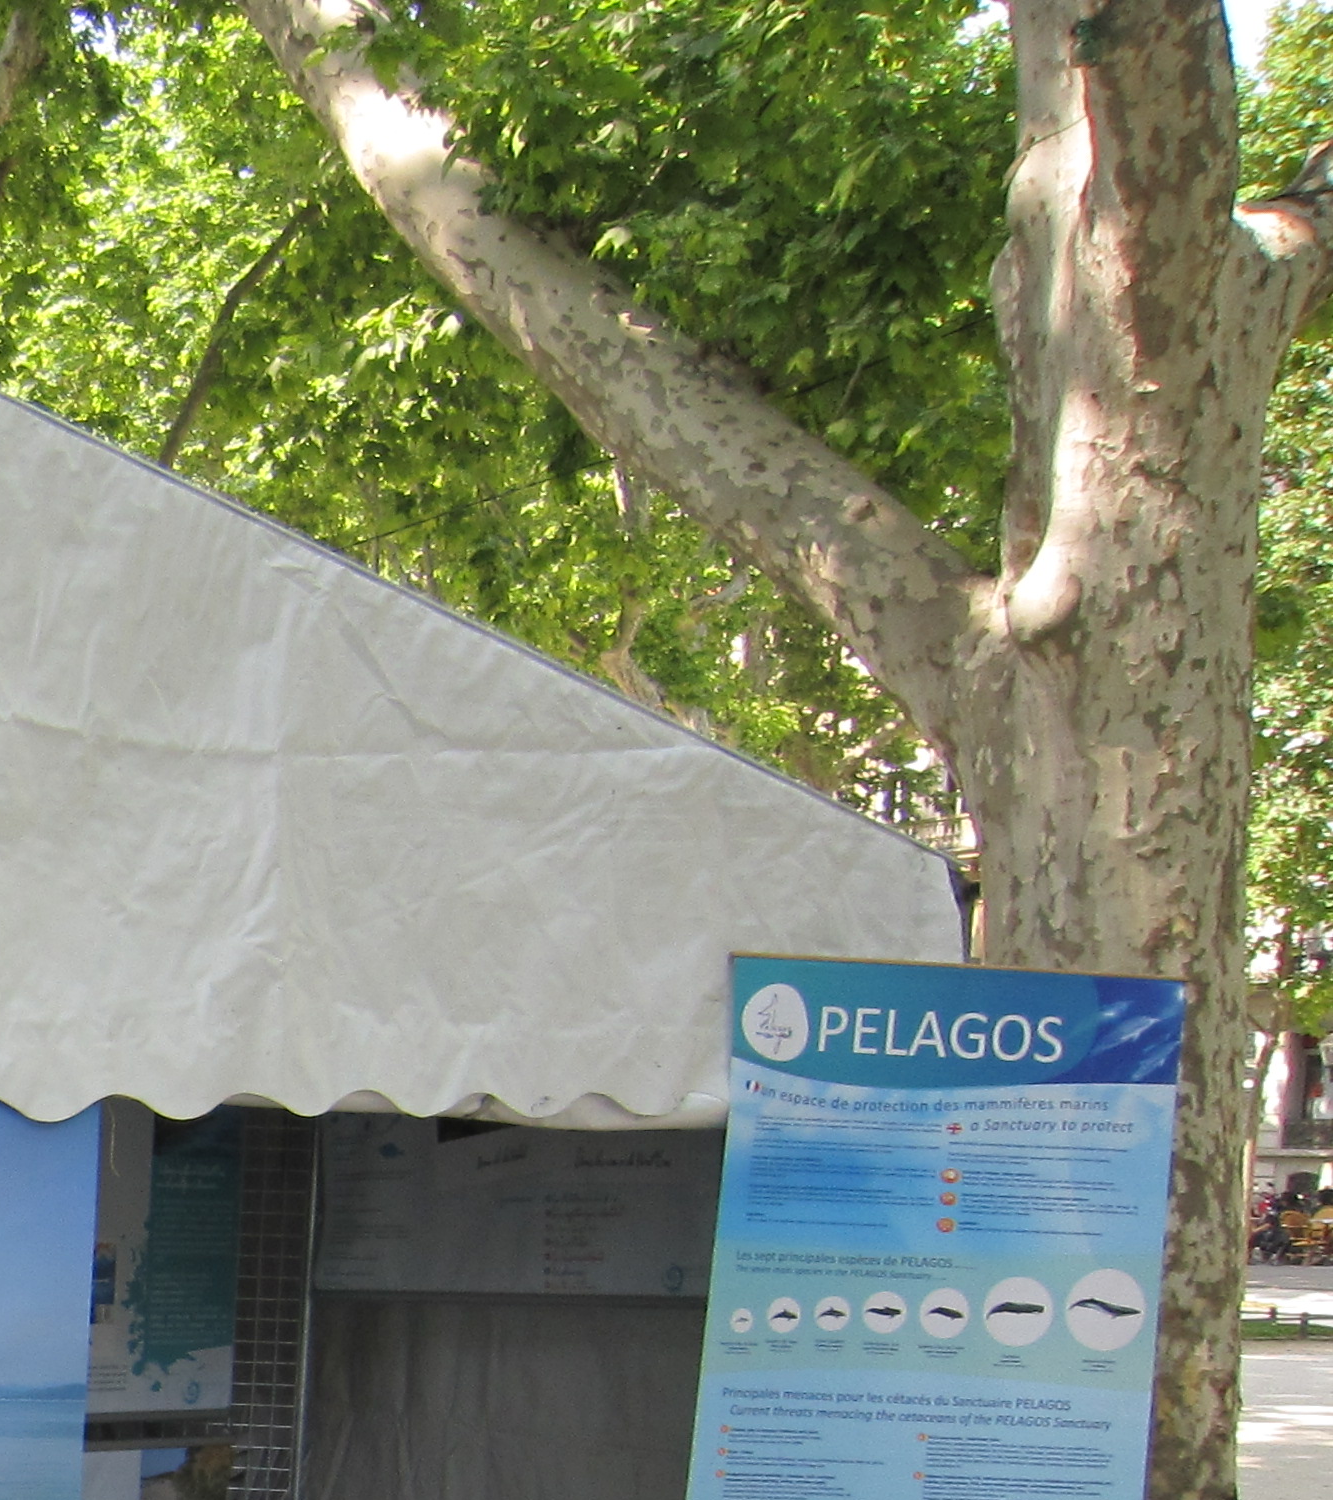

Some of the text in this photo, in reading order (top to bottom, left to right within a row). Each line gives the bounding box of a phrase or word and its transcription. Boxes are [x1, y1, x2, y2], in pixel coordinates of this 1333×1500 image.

[817, 1005, 1064, 1064] PELAGOS
[781, 1091, 826, 1110] espace
[831, 1097, 848, 1110] de
[852, 1099, 929, 1115] protection
[934, 1099, 959, 1112] des
[1059, 1097, 1109, 1112] marins
[984, 1119, 1056, 1136] Sanctuary
[1060, 1119, 1077, 1133] to
[1081, 1118, 1134, 1136] protect
[721, 1386, 781, 1402] Principales
[836, 1391, 865, 1405] pour
[1015, 1397, 1072, 1412] PELAGOS
[875, 1408, 897, 1421] the
[994, 1413, 1051, 1429] PELAGOS
